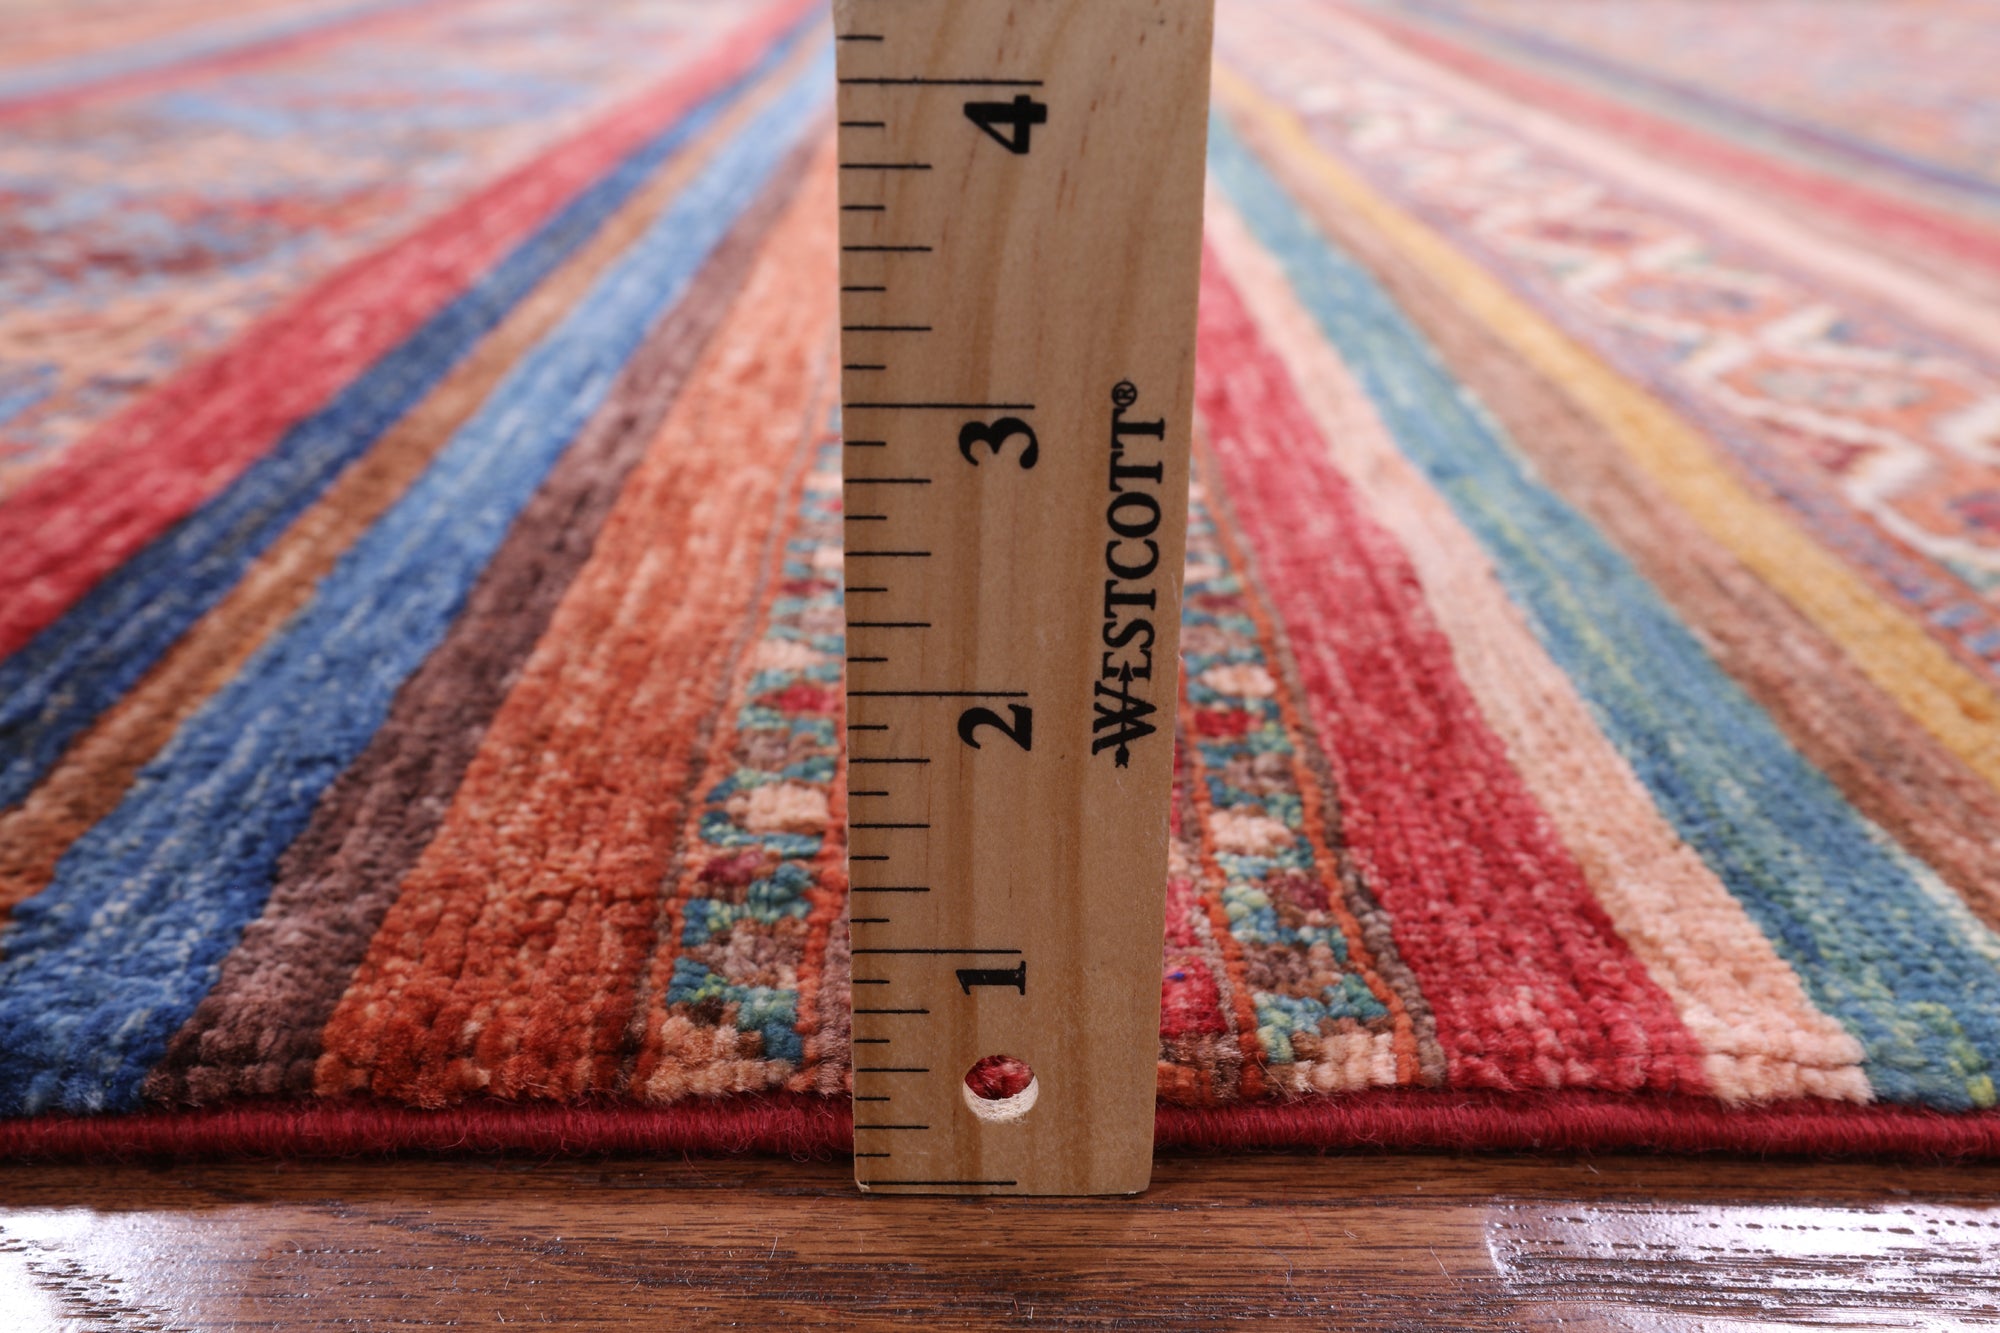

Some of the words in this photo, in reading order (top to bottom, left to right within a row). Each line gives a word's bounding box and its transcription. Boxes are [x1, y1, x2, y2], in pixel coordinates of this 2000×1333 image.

[963, 94, 1048, 156] 4
[958, 416, 1040, 470] 3
[956, 702, 1034, 753] 2
[954, 960, 1028, 997] 1
